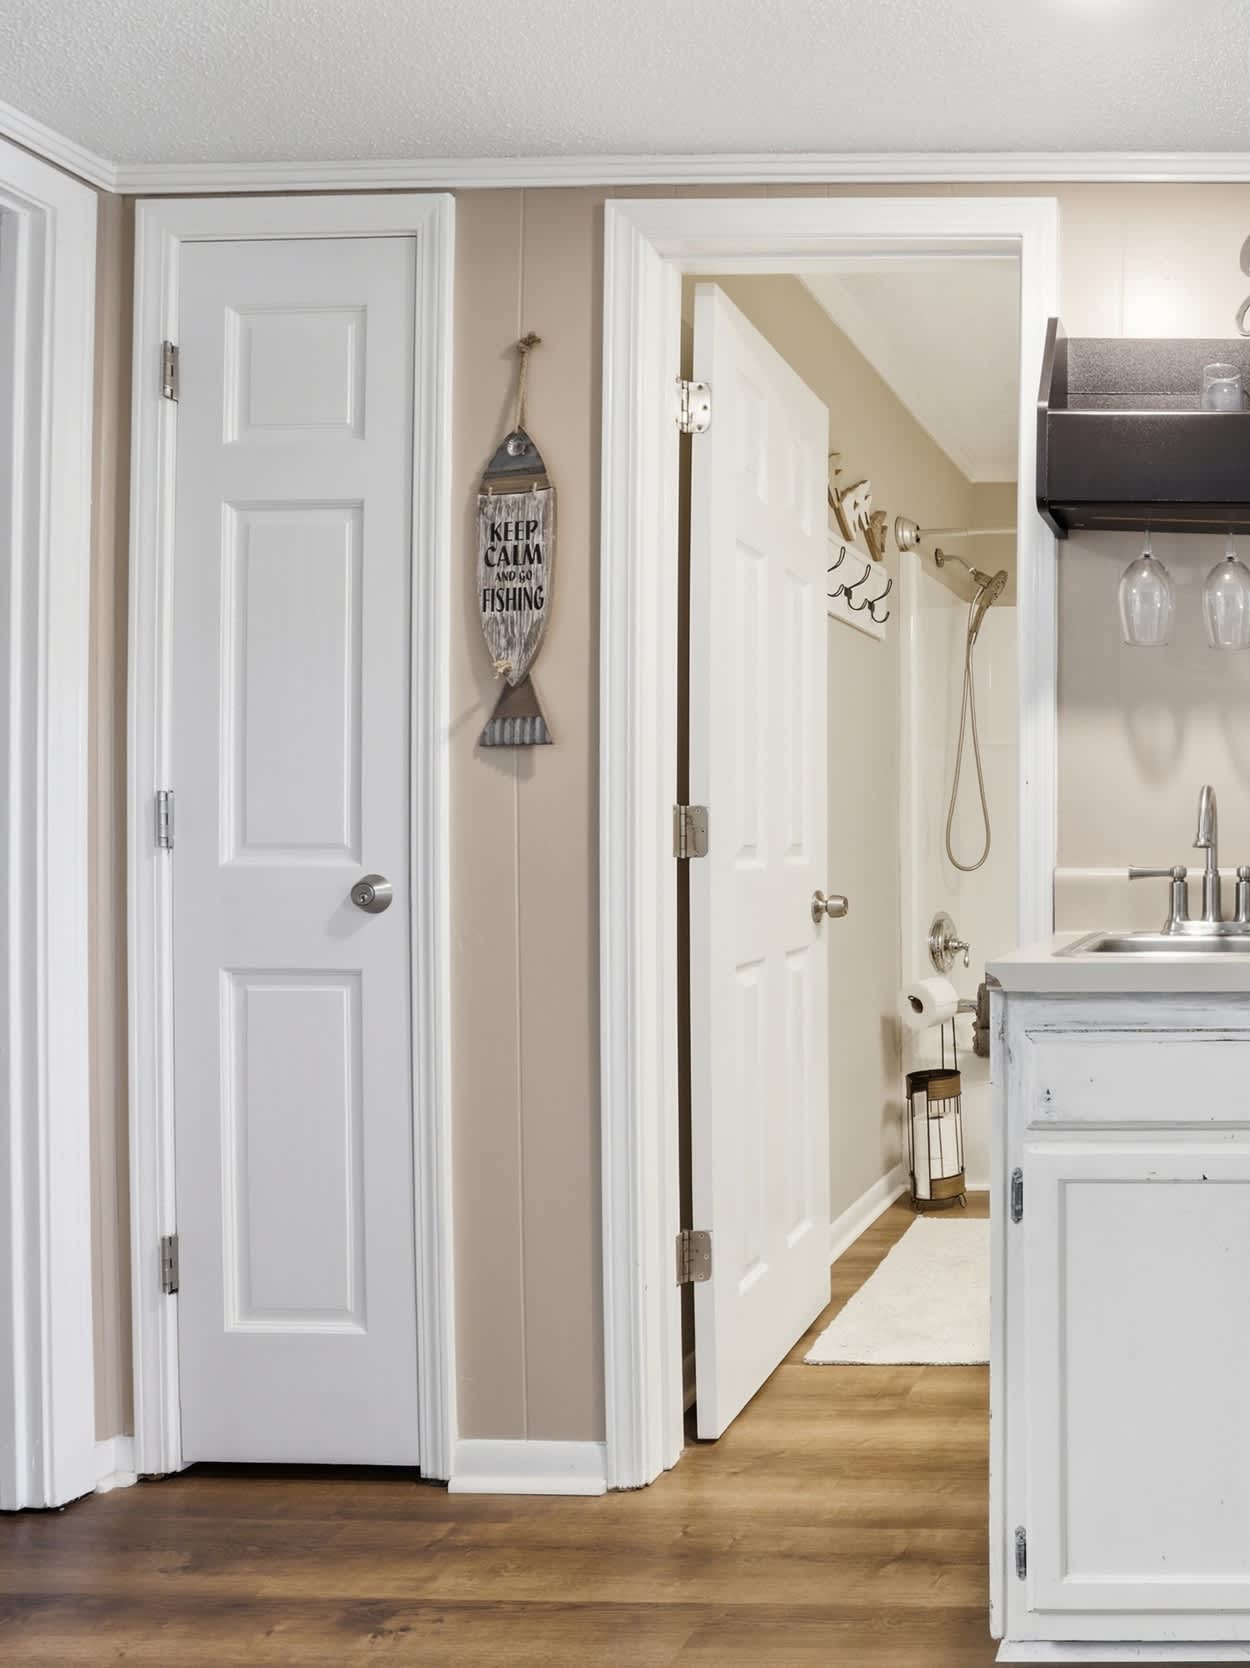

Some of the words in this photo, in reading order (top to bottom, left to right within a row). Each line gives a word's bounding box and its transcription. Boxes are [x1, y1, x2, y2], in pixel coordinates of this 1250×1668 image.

[490, 520, 538, 542] KEEP
[484, 544, 542, 567] CALM
[496, 571, 516, 582] AND
[519, 570, 533, 583] GO
[482, 585, 544, 612] FISHING
